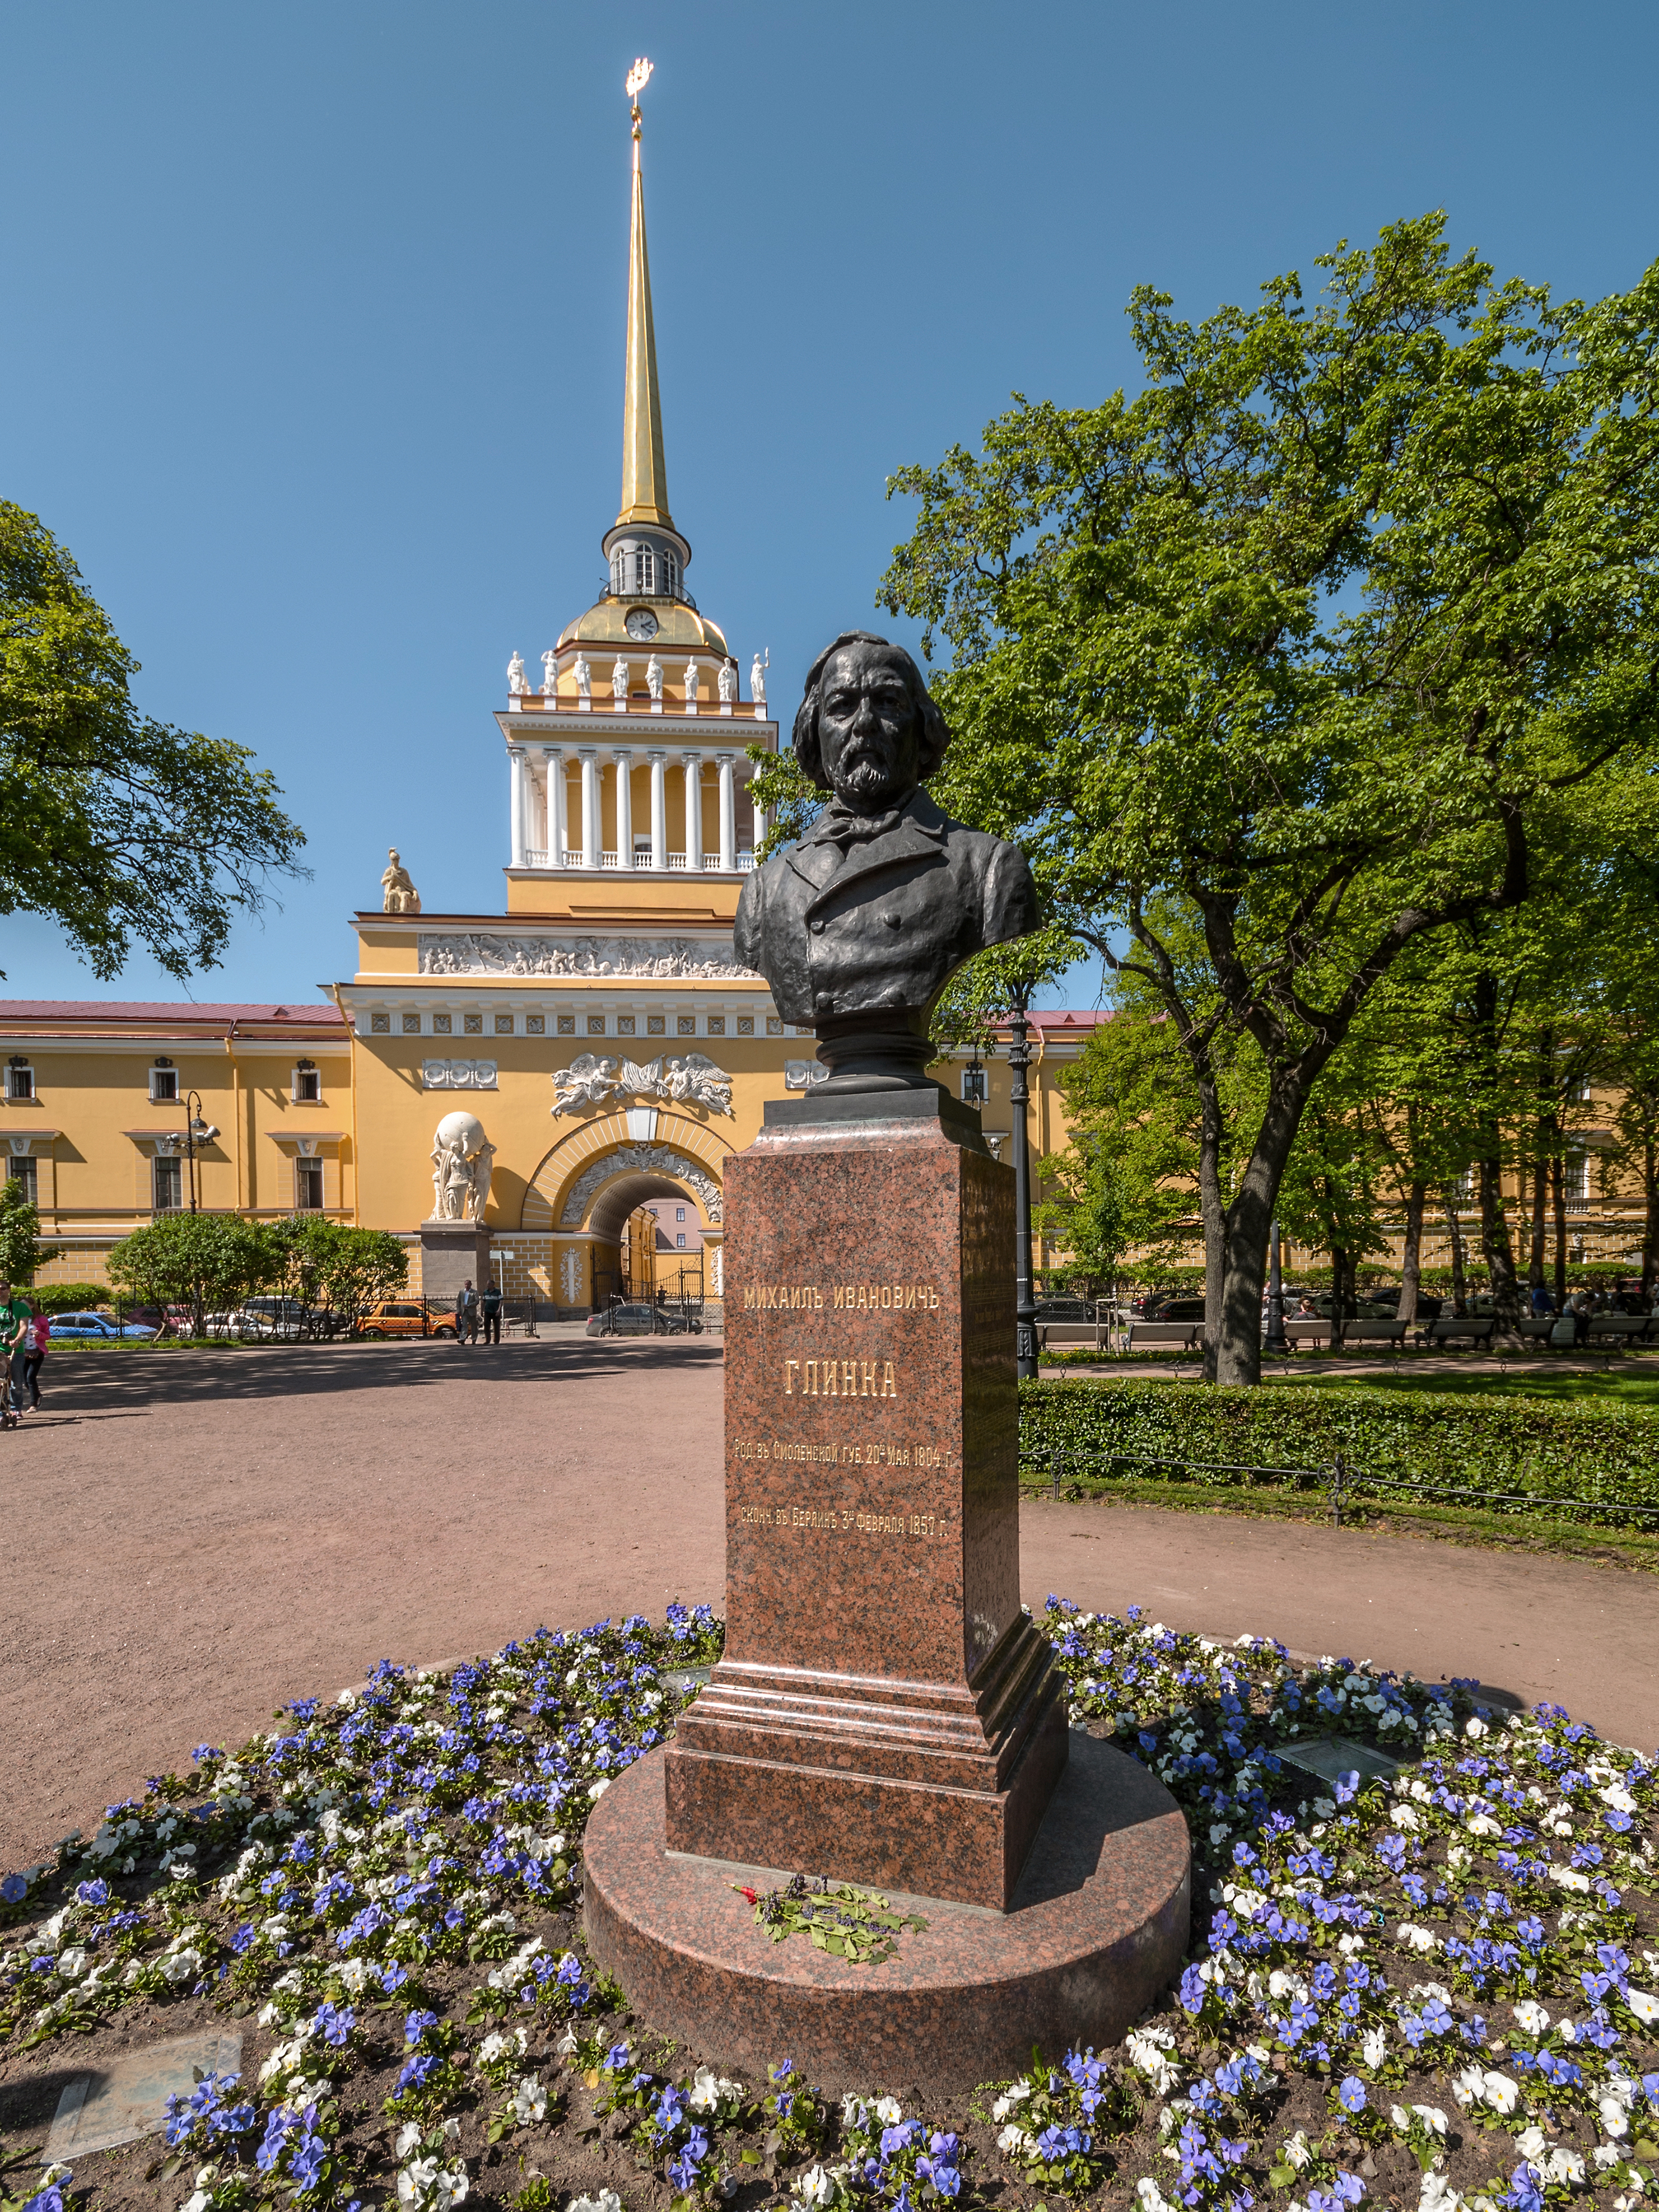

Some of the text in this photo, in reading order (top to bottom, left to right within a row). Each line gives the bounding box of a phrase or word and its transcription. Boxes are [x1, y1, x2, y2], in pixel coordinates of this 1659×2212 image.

[744, 1286, 940, 1309] МИХАИЛЪ ИВАНОВИЧЪ
[784, 1360, 897, 1397] ГЛИНКА
[915, 1447, 940, 1467] 1804
[910, 1515, 935, 1535] 1857
